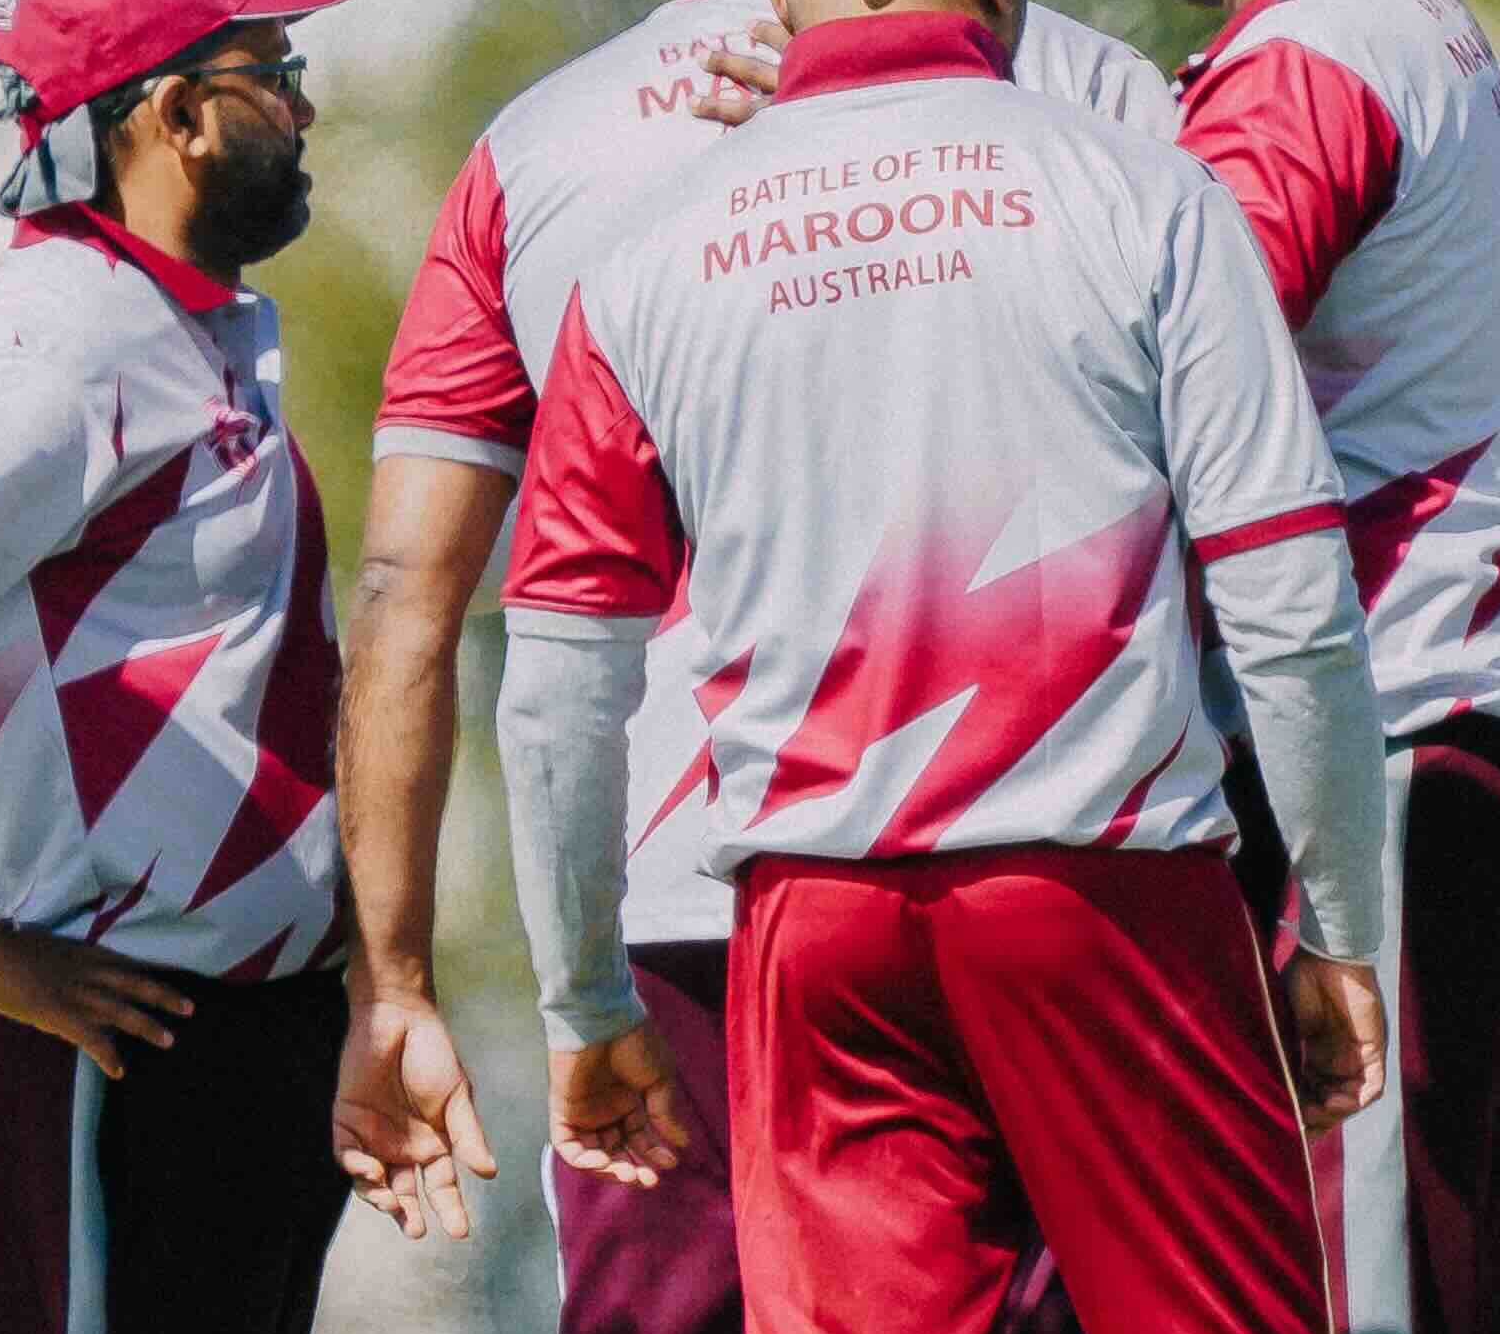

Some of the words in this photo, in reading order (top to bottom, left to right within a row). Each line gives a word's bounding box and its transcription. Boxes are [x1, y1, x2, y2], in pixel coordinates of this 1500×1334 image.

[729, 160, 861, 216] BATTLE
[871, 149, 923, 182] OF
[932, 143, 1005, 172] THE
[702, 188, 1037, 283] MAROONS
[769, 249, 974, 315] AUSTRALIA
